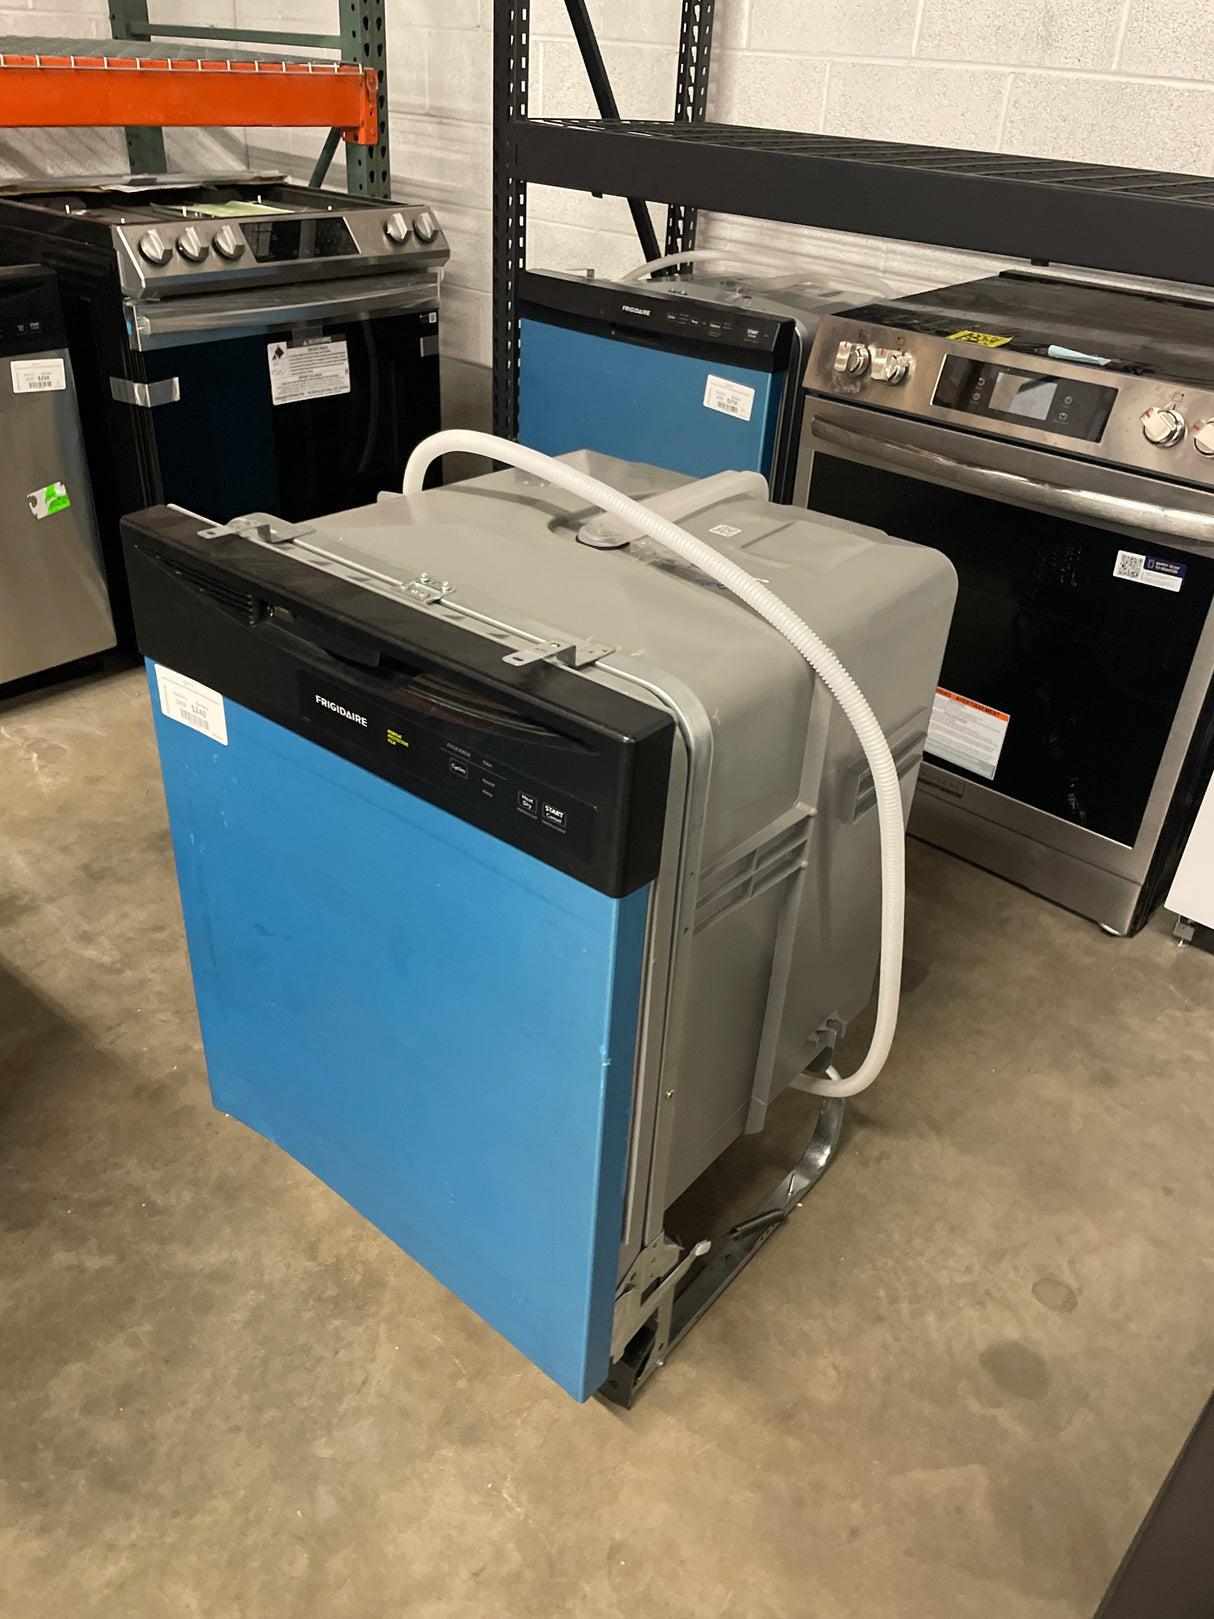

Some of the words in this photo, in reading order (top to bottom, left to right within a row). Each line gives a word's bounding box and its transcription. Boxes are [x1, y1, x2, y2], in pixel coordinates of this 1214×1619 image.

[621, 305, 651, 317] FRIGIDAIRE
[314, 694, 368, 728] FRIGIDAIRE
[544, 805, 564, 818] START
